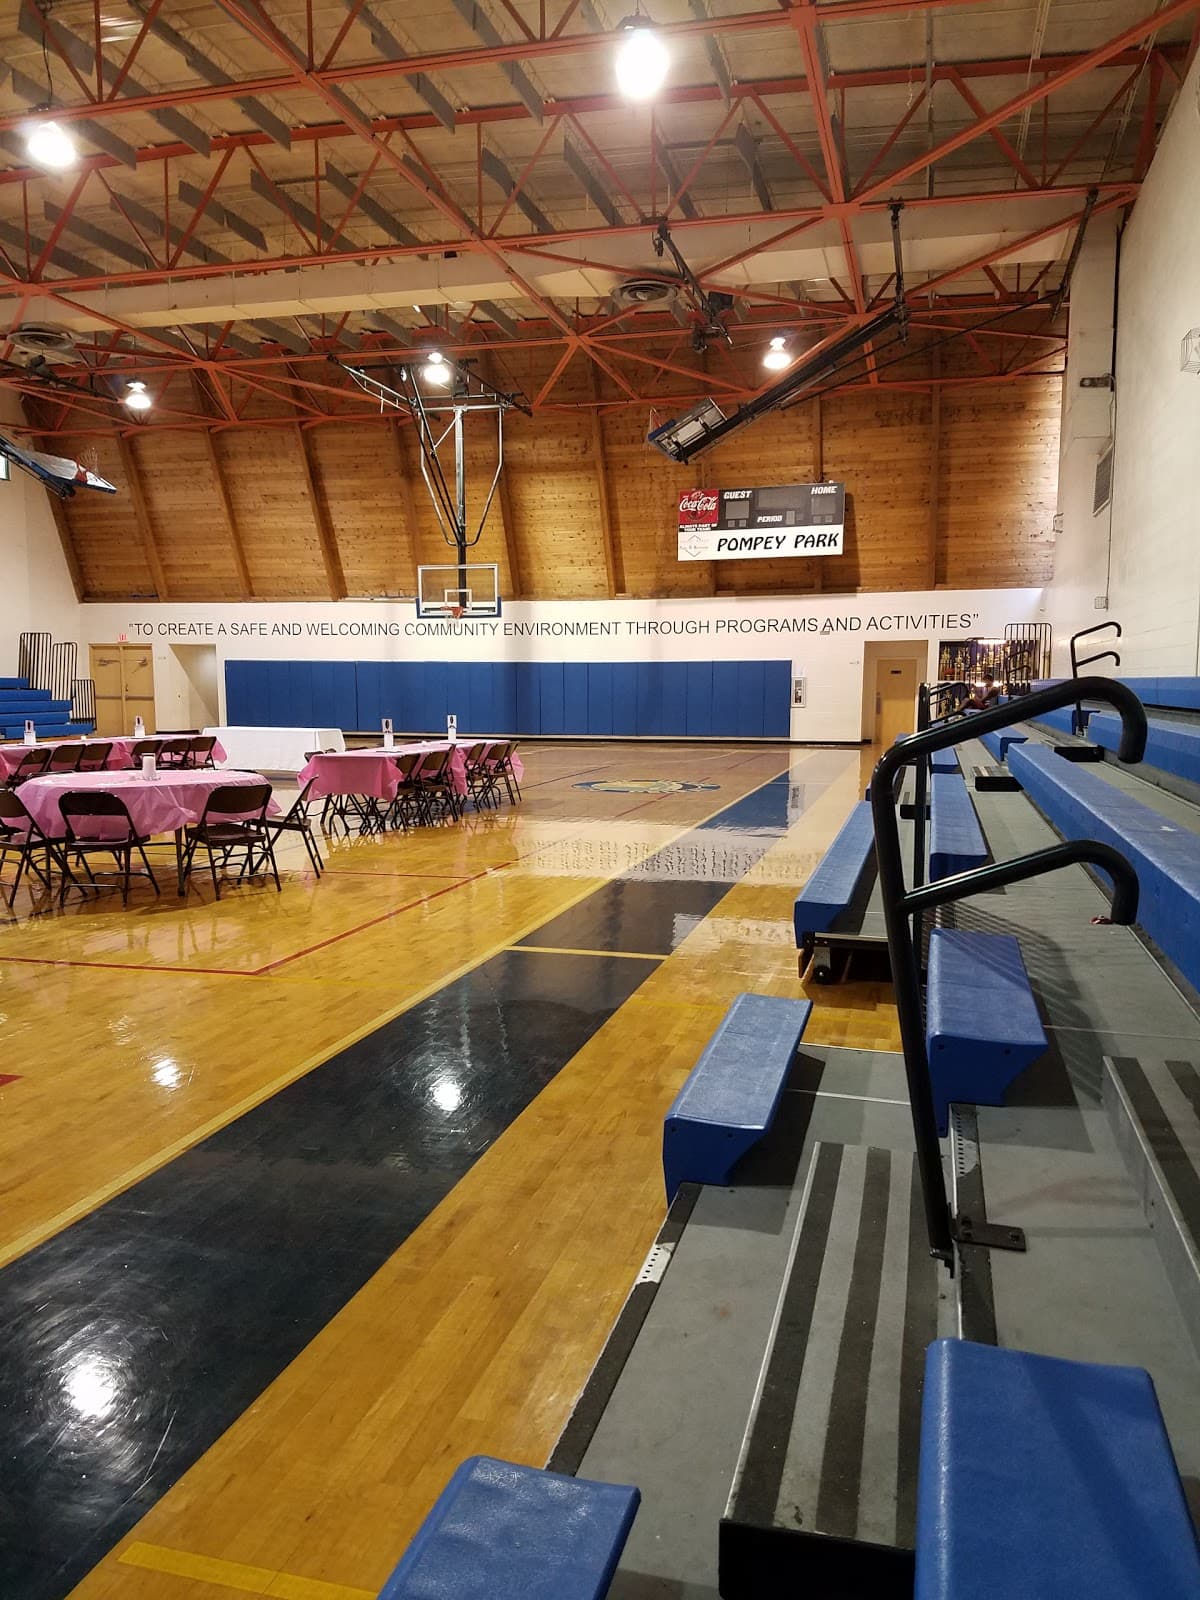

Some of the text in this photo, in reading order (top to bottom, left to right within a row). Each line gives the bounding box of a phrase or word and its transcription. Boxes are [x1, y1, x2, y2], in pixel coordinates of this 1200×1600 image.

[723, 490, 753, 500] GUEST
[810, 486, 838, 495] HOME
[717, 533, 839, 552] POMPEY PARK
[157, 622, 214, 636] CREATE
[217, 623, 227, 636] A
[230, 622, 268, 636] SAFE
[271, 623, 302, 636] AND
[306, 622, 400, 636] WELCOMING
[404, 622, 499, 636] COMMUNITY
[503, 621, 621, 636] ENVIRONMENT
[625, 620, 710, 635] THROUGH
[715, 617, 819, 633] PROGRAMS
[821, 616, 862, 632] AND
